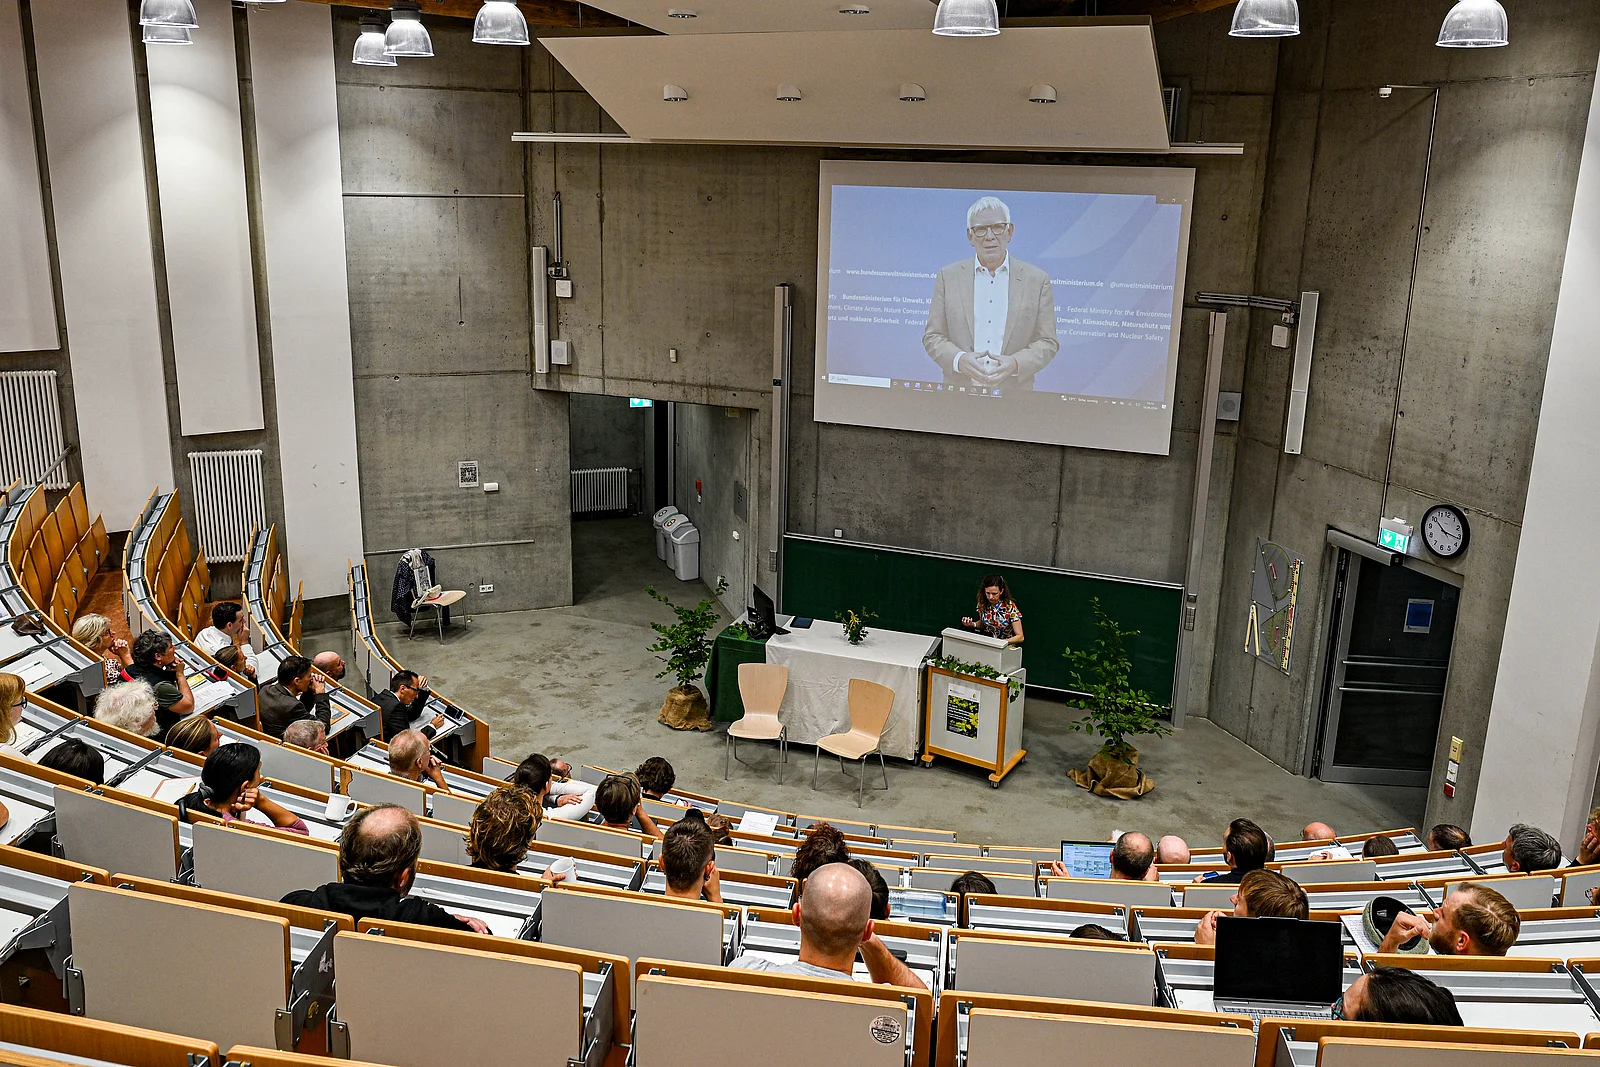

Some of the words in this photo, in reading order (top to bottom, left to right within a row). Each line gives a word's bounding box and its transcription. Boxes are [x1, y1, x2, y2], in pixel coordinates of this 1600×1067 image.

[846, 269, 937, 279] www.bundesumweltministerium.de
[1110, 281, 1173, 290] @umweltministerium
[843, 294, 891, 303] Bundesministerium
[884, 306, 901, 314] Nature
[1067, 305, 1088, 313] Federal
[1089, 307, 1113, 316] Ministry
[873, 317, 900, 325] Sicherheit
[1056, 316, 1081, 325] Umwelt,
[1082, 318, 1120, 327] Klimaschutz,
[1121, 320, 1158, 329] Naturschutz
[1068, 328, 1106, 337] Conservation
[1107, 331, 1119, 339] and
[1120, 332, 1143, 340] Nuclear
[1144, 333, 1164, 342] Safety
